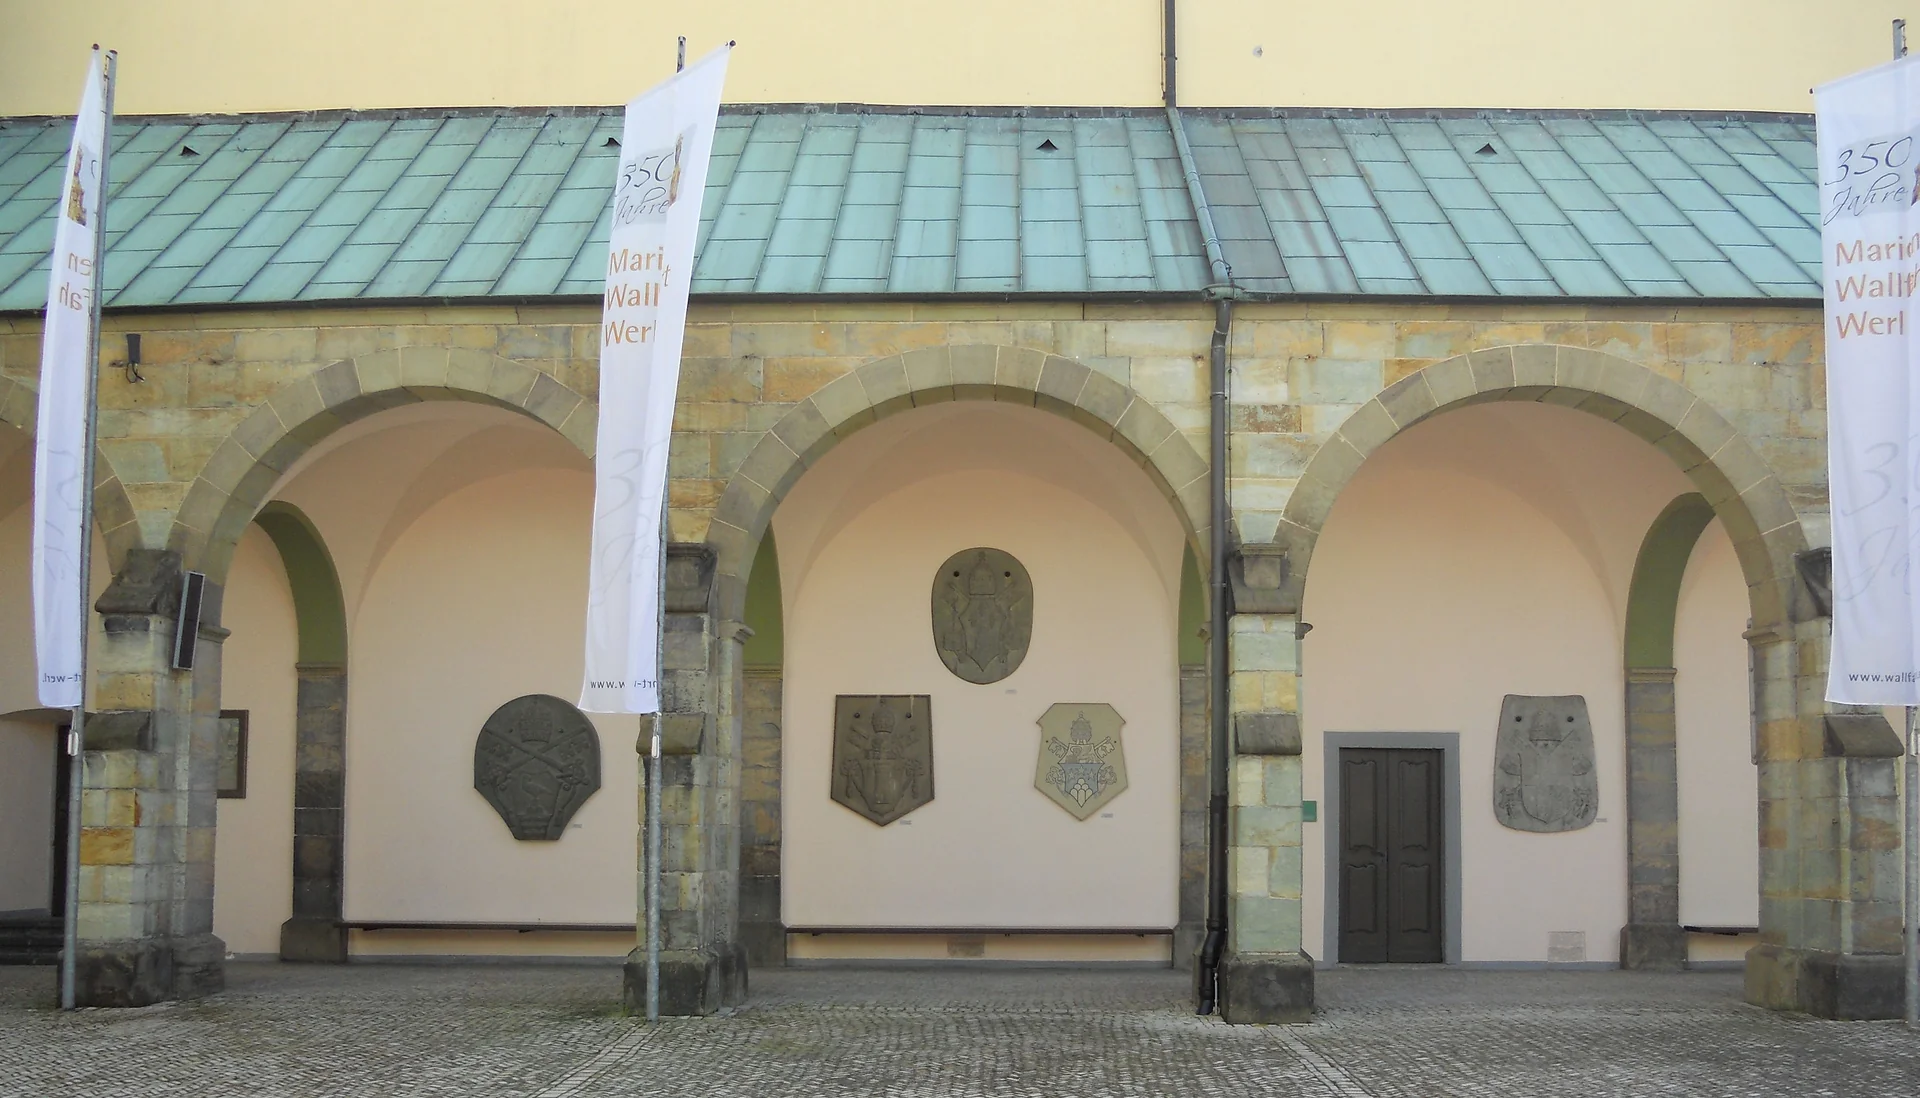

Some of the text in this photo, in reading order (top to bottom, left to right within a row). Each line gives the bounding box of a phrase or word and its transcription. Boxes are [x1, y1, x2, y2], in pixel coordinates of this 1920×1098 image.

[1824, 135, 1913, 186] 350
[612, 186, 671, 232] Jahre
[1823, 172, 1909, 227] Jahre
[1835, 310, 1905, 340] Werl
